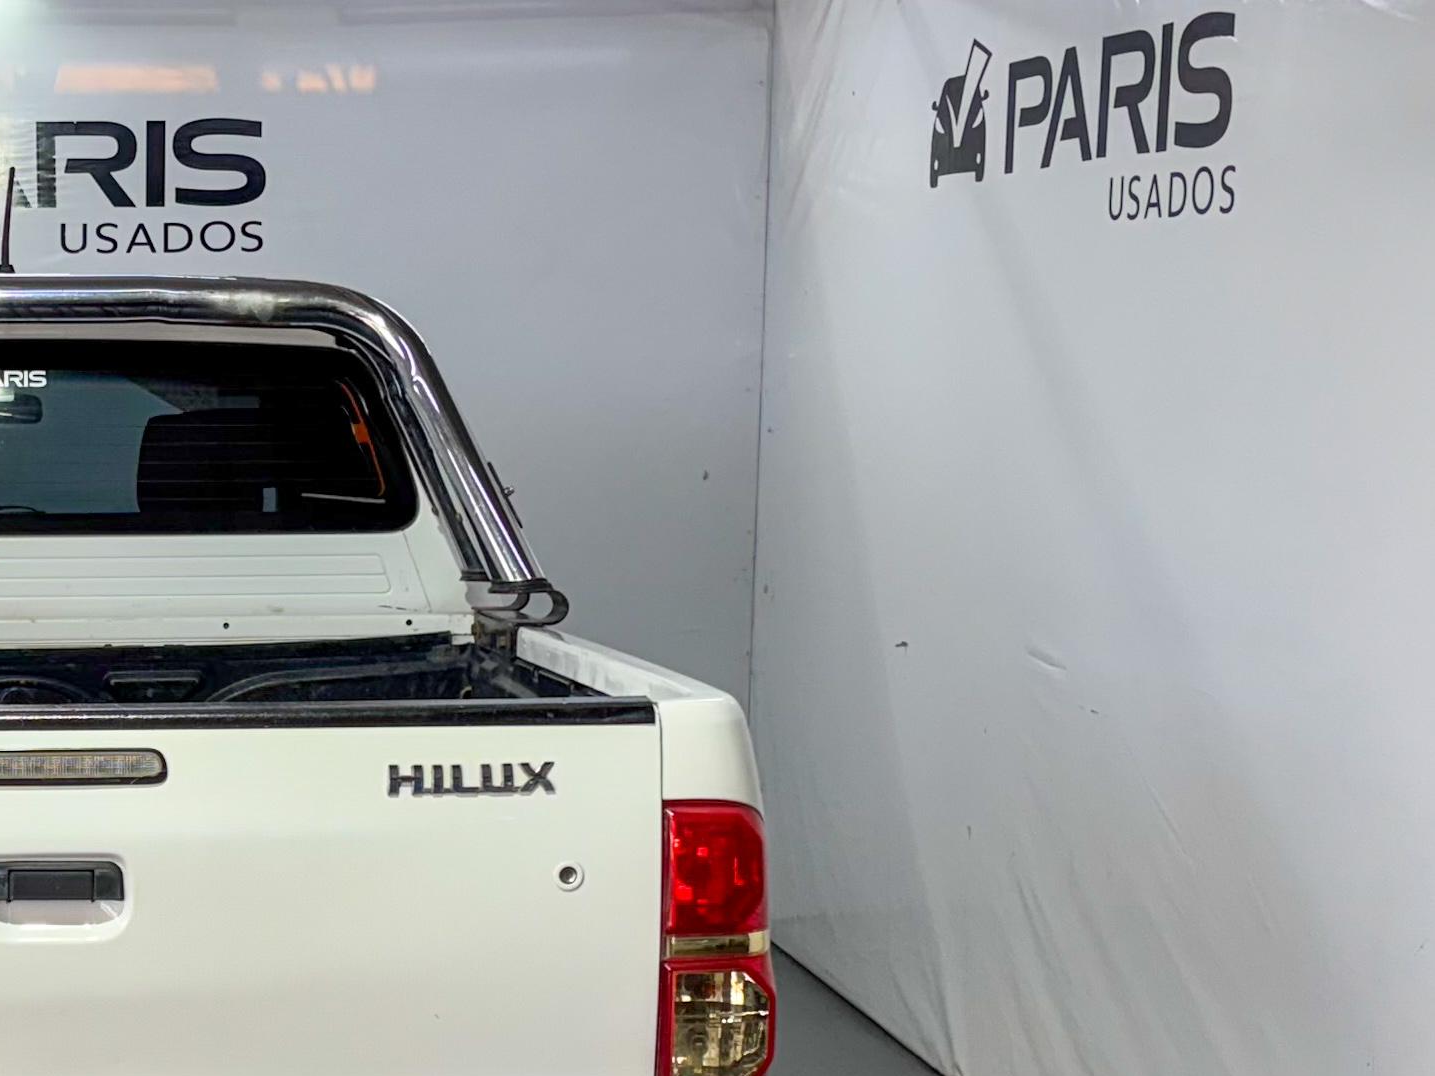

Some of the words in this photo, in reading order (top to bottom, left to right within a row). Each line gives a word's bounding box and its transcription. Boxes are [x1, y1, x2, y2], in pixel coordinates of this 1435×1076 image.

[1004, 11, 1235, 174] PARIS
[1108, 165, 1236, 221] USADOS
[59, 220, 264, 254] USADOS
[388, 761, 556, 797] HILUX
